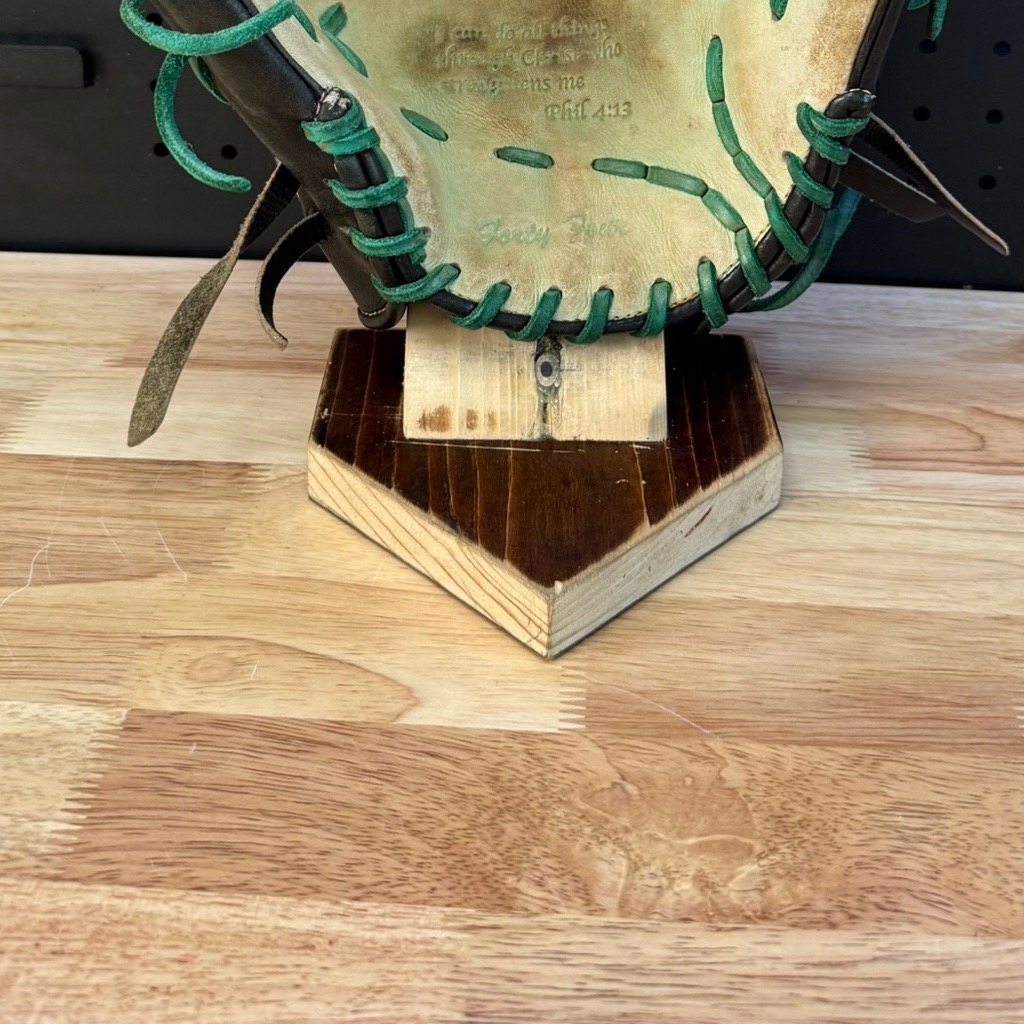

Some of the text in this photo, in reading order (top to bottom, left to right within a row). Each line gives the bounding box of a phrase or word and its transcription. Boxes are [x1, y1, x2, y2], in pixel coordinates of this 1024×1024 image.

[556, 75, 585, 90] me
[544, 98, 633, 122] Phil 4:13
[476, 218, 550, 250] Forty
